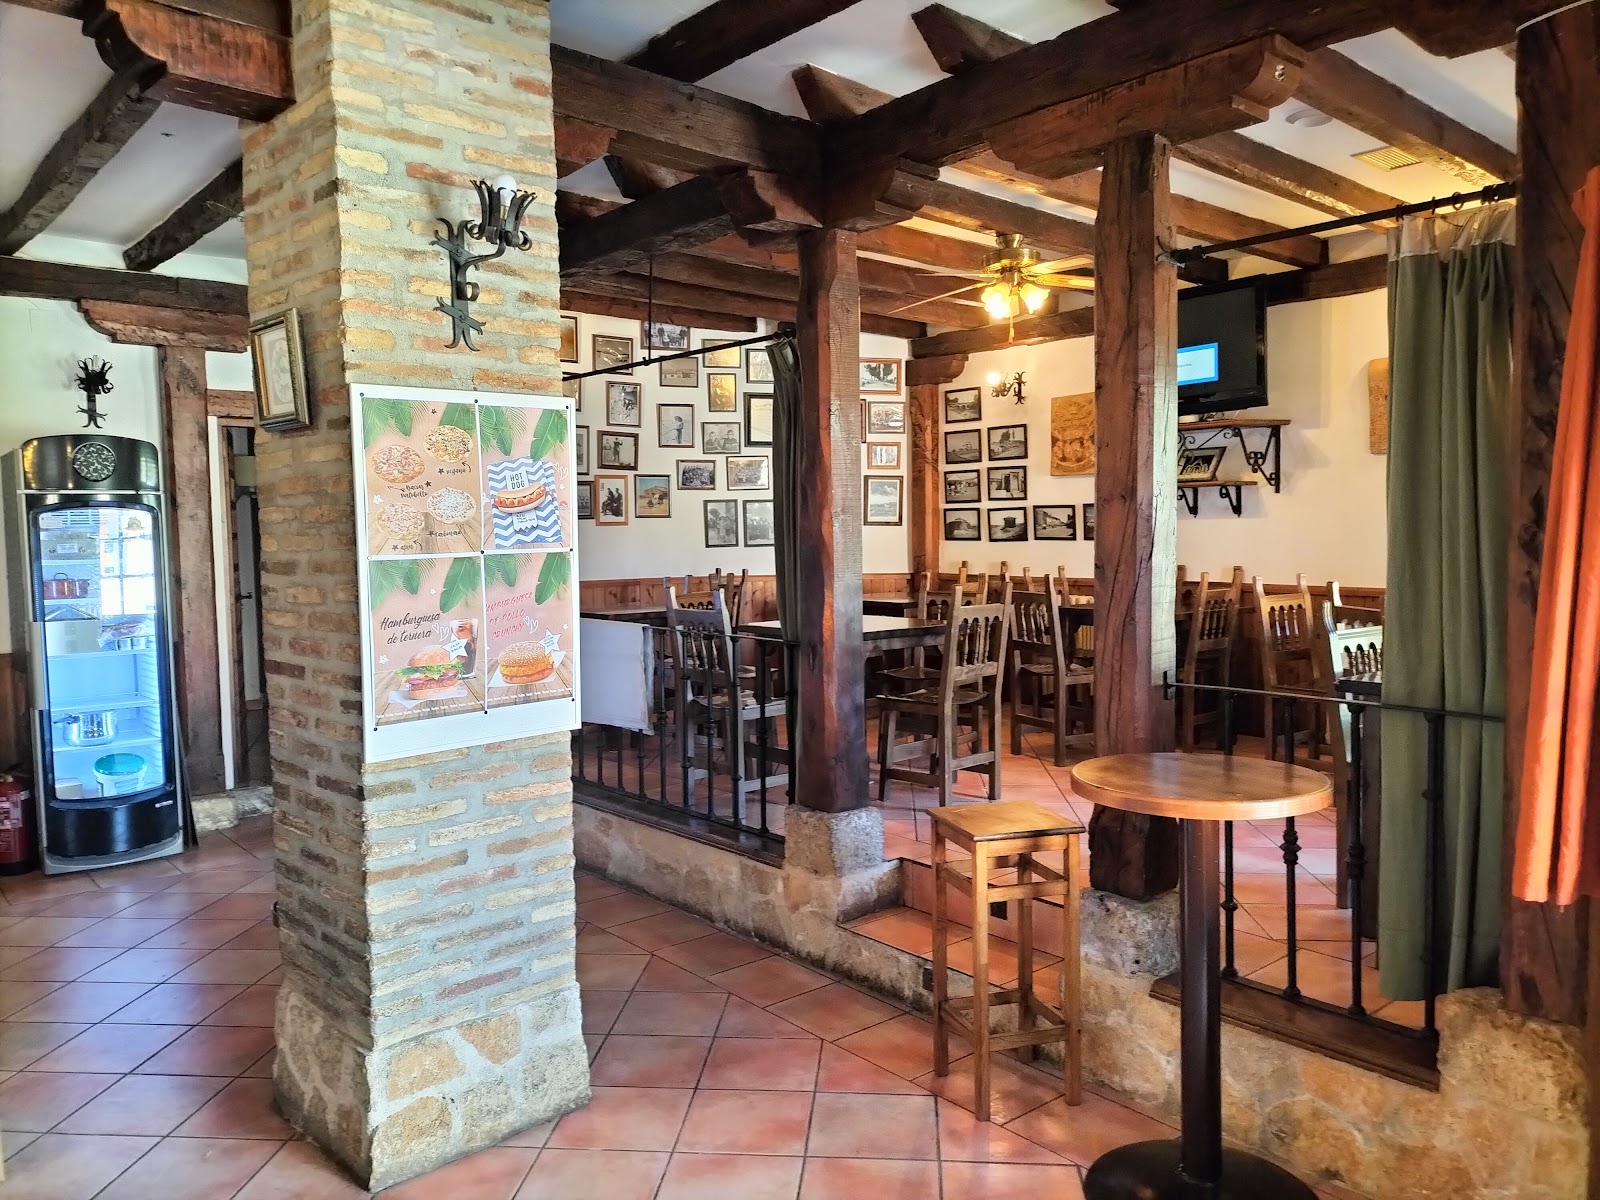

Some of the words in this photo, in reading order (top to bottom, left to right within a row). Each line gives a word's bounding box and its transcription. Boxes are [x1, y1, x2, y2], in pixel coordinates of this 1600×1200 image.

[509, 472, 523, 482] HOT
[511, 480, 525, 490] DOG
[380, 612, 440, 631] Hamburguesa
[386, 632, 398, 645] de
[399, 629, 432, 643] ternera
